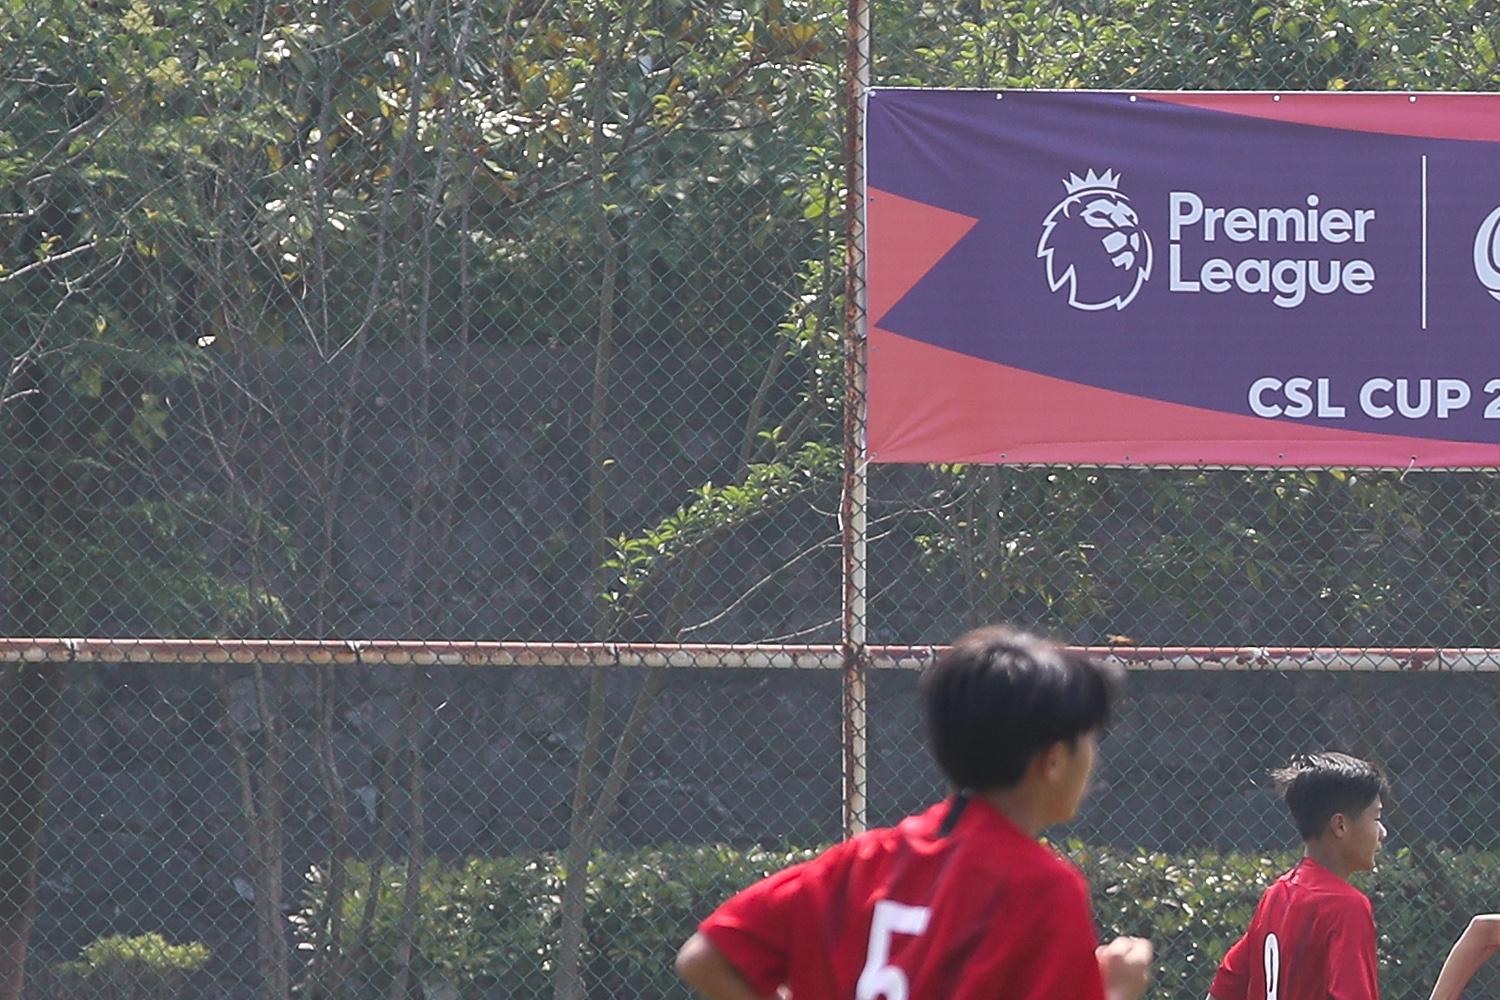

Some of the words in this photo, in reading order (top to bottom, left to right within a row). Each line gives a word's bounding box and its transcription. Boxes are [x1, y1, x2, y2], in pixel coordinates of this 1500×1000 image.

[1169, 191, 1375, 243] Premier
[1169, 243, 1375, 308] League
[1247, 377, 1346, 419] CSL
[1359, 377, 1471, 419] CUP
